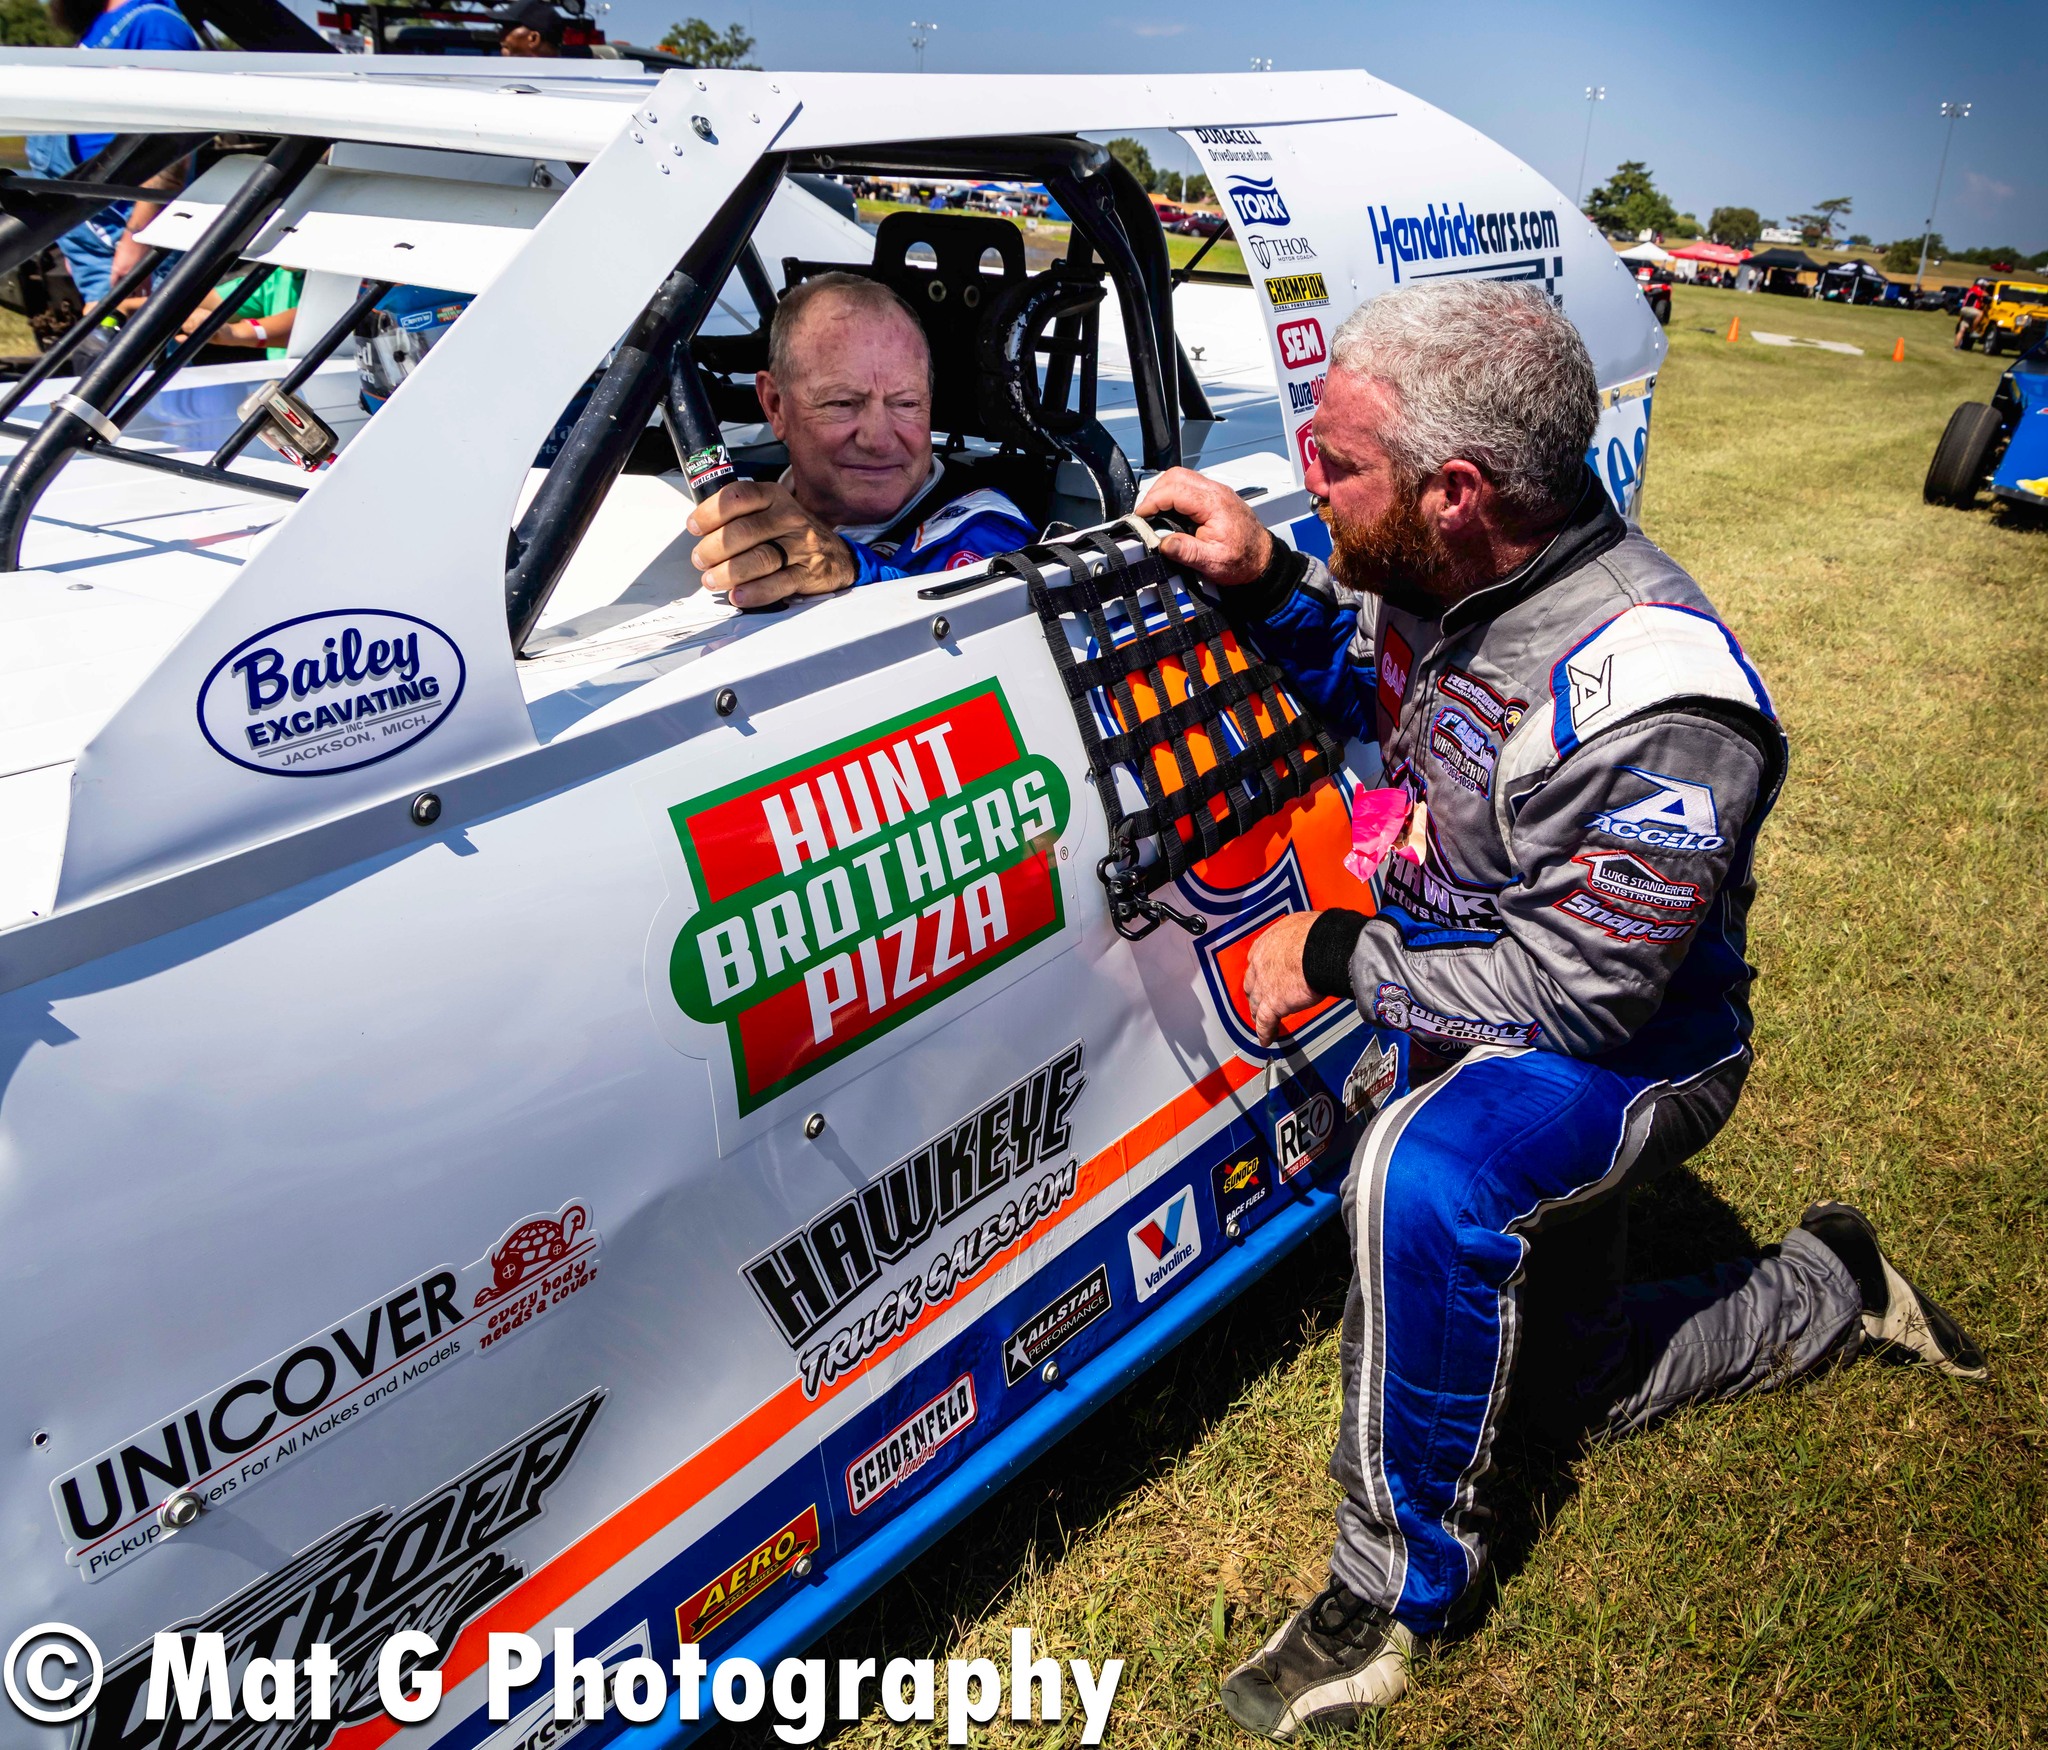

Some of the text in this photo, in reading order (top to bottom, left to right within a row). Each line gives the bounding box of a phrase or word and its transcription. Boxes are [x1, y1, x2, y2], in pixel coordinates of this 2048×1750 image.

[1194, 128, 1262, 144] DURACELL
[1208, 148, 1273, 162] DriveDuracell.com
[1232, 193, 1287, 220] TORK
[1266, 237, 1317, 257] THOR
[1367, 202, 1560, 284] Hendrickcars.com
[1266, 273, 1329, 304] CHAMPION
[1282, 322, 1323, 363] SEM
[1288, 376, 1324, 410] Duraglo
[232, 627, 420, 712] Bailey
[246, 676, 440, 749] EXCAVATING
[1445, 672, 1506, 717] RENEGADE
[281, 714, 431, 767] JACKSON, MICH.
[345, 721, 364, 734] INC
[1460, 758, 1490, 790] SERVI
[761, 720, 963, 876] HUNT
[1584, 814, 1727, 850] ACCELO
[696, 770, 1057, 1008] BROTHERS
[1591, 879, 1691, 908] CONSTRUCTION
[1601, 867, 1695, 897] LUKE STANDERFER
[803, 871, 1009, 1046] PIZZA
[1410, 1004, 1529, 1039] DIEPHOLZ
[1434, 1025, 1497, 1043] FARM
[741, 1043, 1088, 1352] HAWKEYE
[1224, 1158, 1259, 1192] SUNOCO
[1225, 1187, 1266, 1224] RACE FUELS
[487, 1259, 587, 1330] every body
[799, 1158, 1079, 1400] TRUCK SALES.COM
[479, 1267, 598, 1351] needs a cover
[1025, 1278, 1102, 1348] ALLSTAR
[1028, 1294, 1105, 1360] PERFORMANCE
[60, 1271, 465, 1542] UNICOVER
[89, 1523, 162, 1575] Pickup
[242, 1455, 271, 1483] For
[275, 1436, 298, 1464] All
[302, 1401, 360, 1448] Makes
[363, 1376, 399, 1408] and
[402, 1339, 461, 1386] Models
[853, 1384, 969, 1504] SCHOENFELD
[698, 1530, 796, 1619] AERO
[747, 1562, 781, 1590] WHEELS
